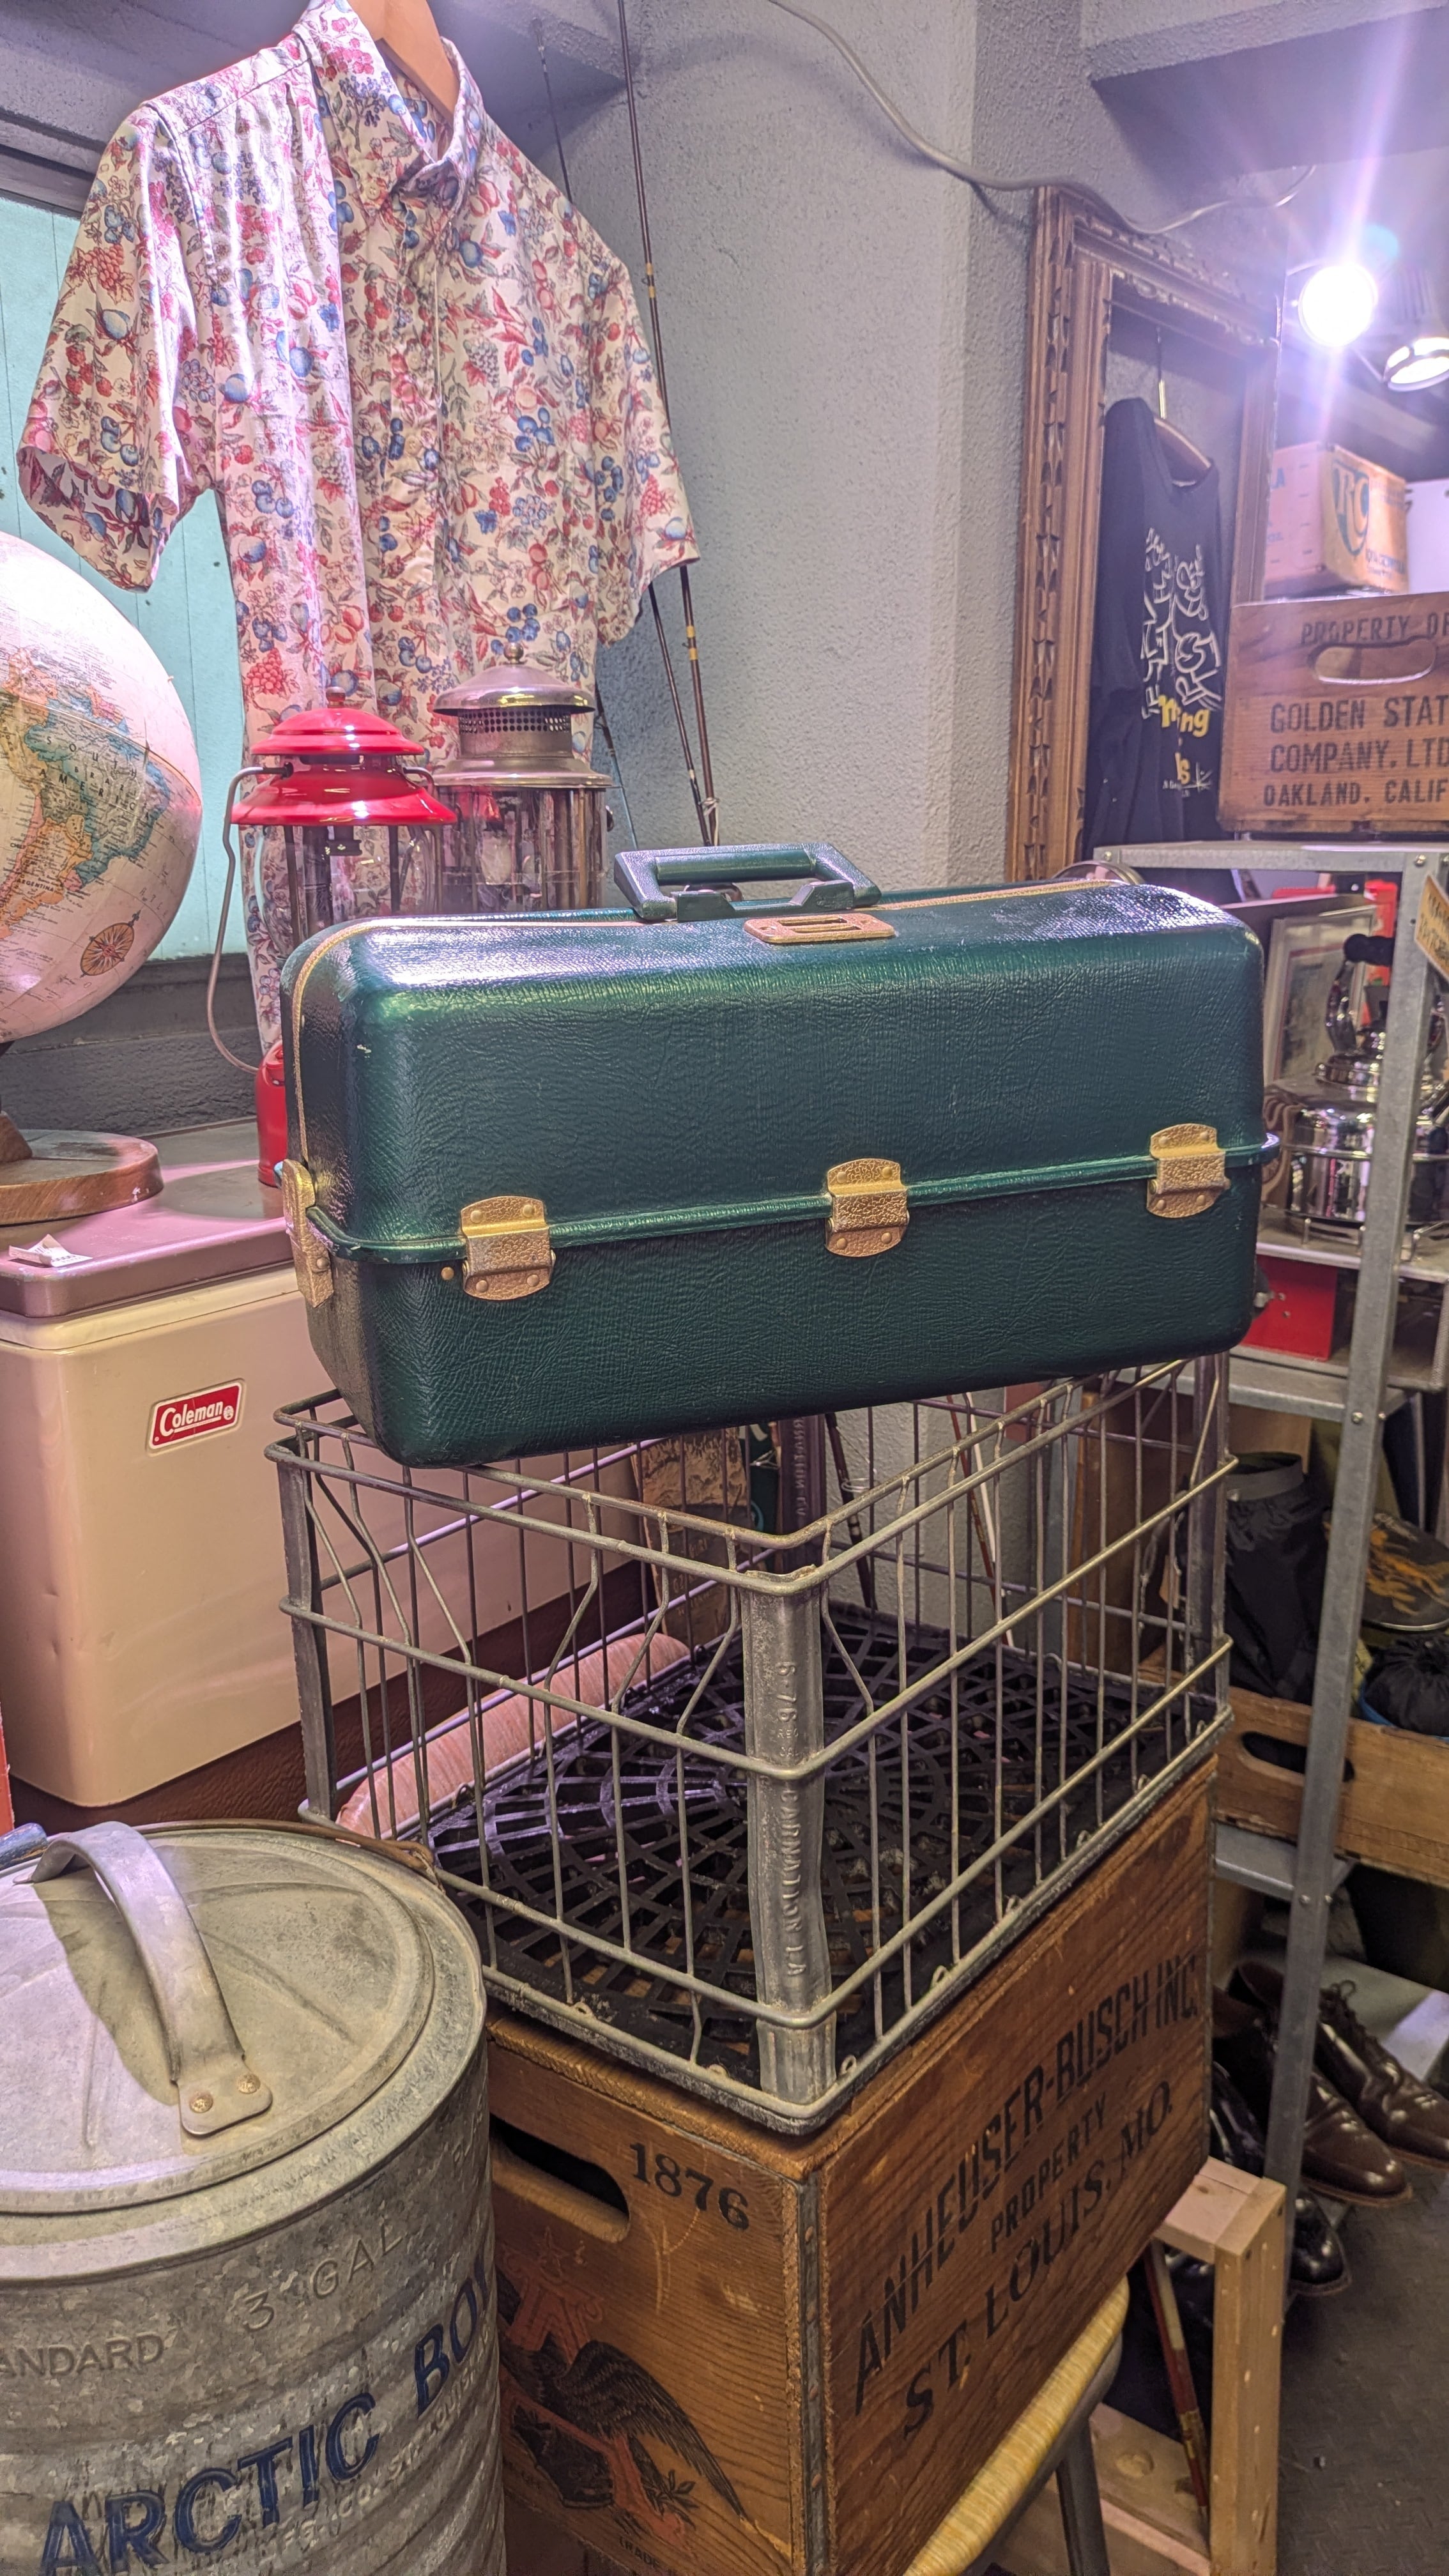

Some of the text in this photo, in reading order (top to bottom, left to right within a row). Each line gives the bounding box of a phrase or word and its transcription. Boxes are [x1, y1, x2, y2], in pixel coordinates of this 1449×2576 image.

[1301, 615, 1411, 644] PROPERTY
[1270, 699, 1365, 733] GOLDEN
[160, 1401, 224, 1437] Coleman
[629, 2142, 750, 2230] 1876
[990, 2091, 1107, 2254] PROPERTY
[242, 2288, 275, 2331] 3
[40, 2391, 379, 2576] ARCTIC
